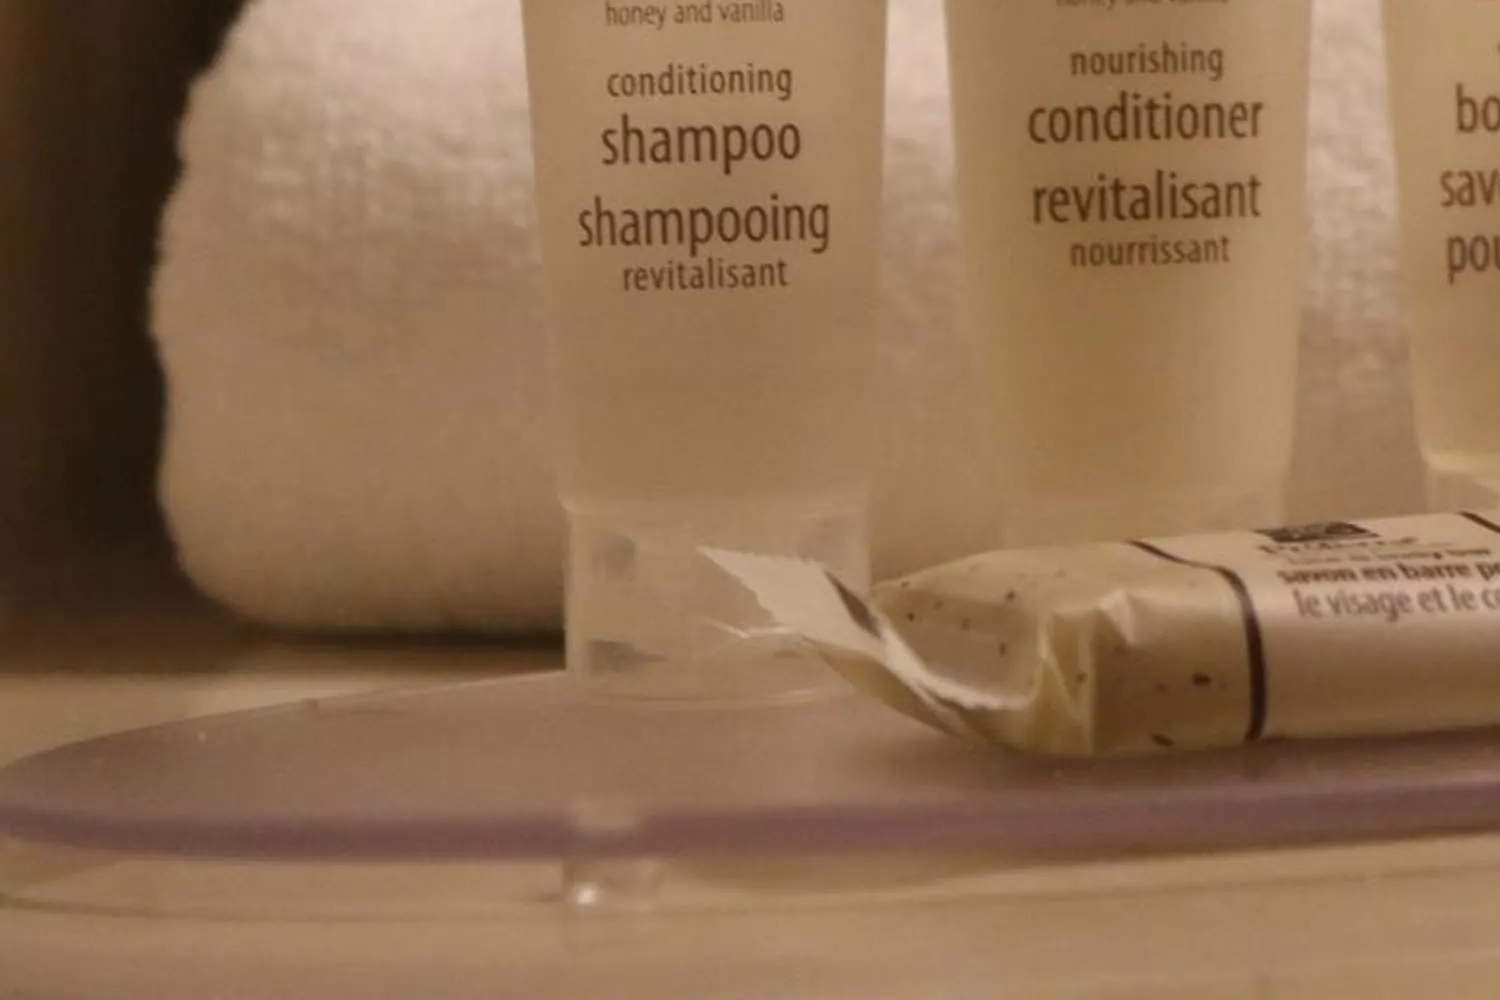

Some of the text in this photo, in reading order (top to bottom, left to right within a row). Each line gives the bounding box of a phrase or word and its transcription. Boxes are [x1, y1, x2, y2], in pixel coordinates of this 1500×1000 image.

[605, 0, 667, 30] honey
[606, 63, 793, 101] conditioning
[1070, 41, 1223, 82] nourishing
[1027, 90, 1264, 145] conditioner
[601, 112, 802, 176] shampoo
[1032, 168, 1262, 225] revitalisant
[578, 193, 830, 258] shampooing
[1070, 234, 1231, 268] nourrissant
[622, 257, 788, 292] revitalisant
[1293, 587, 1325, 618] le
[1326, 583, 1416, 623] visage
[1416, 582, 1449, 614] et
